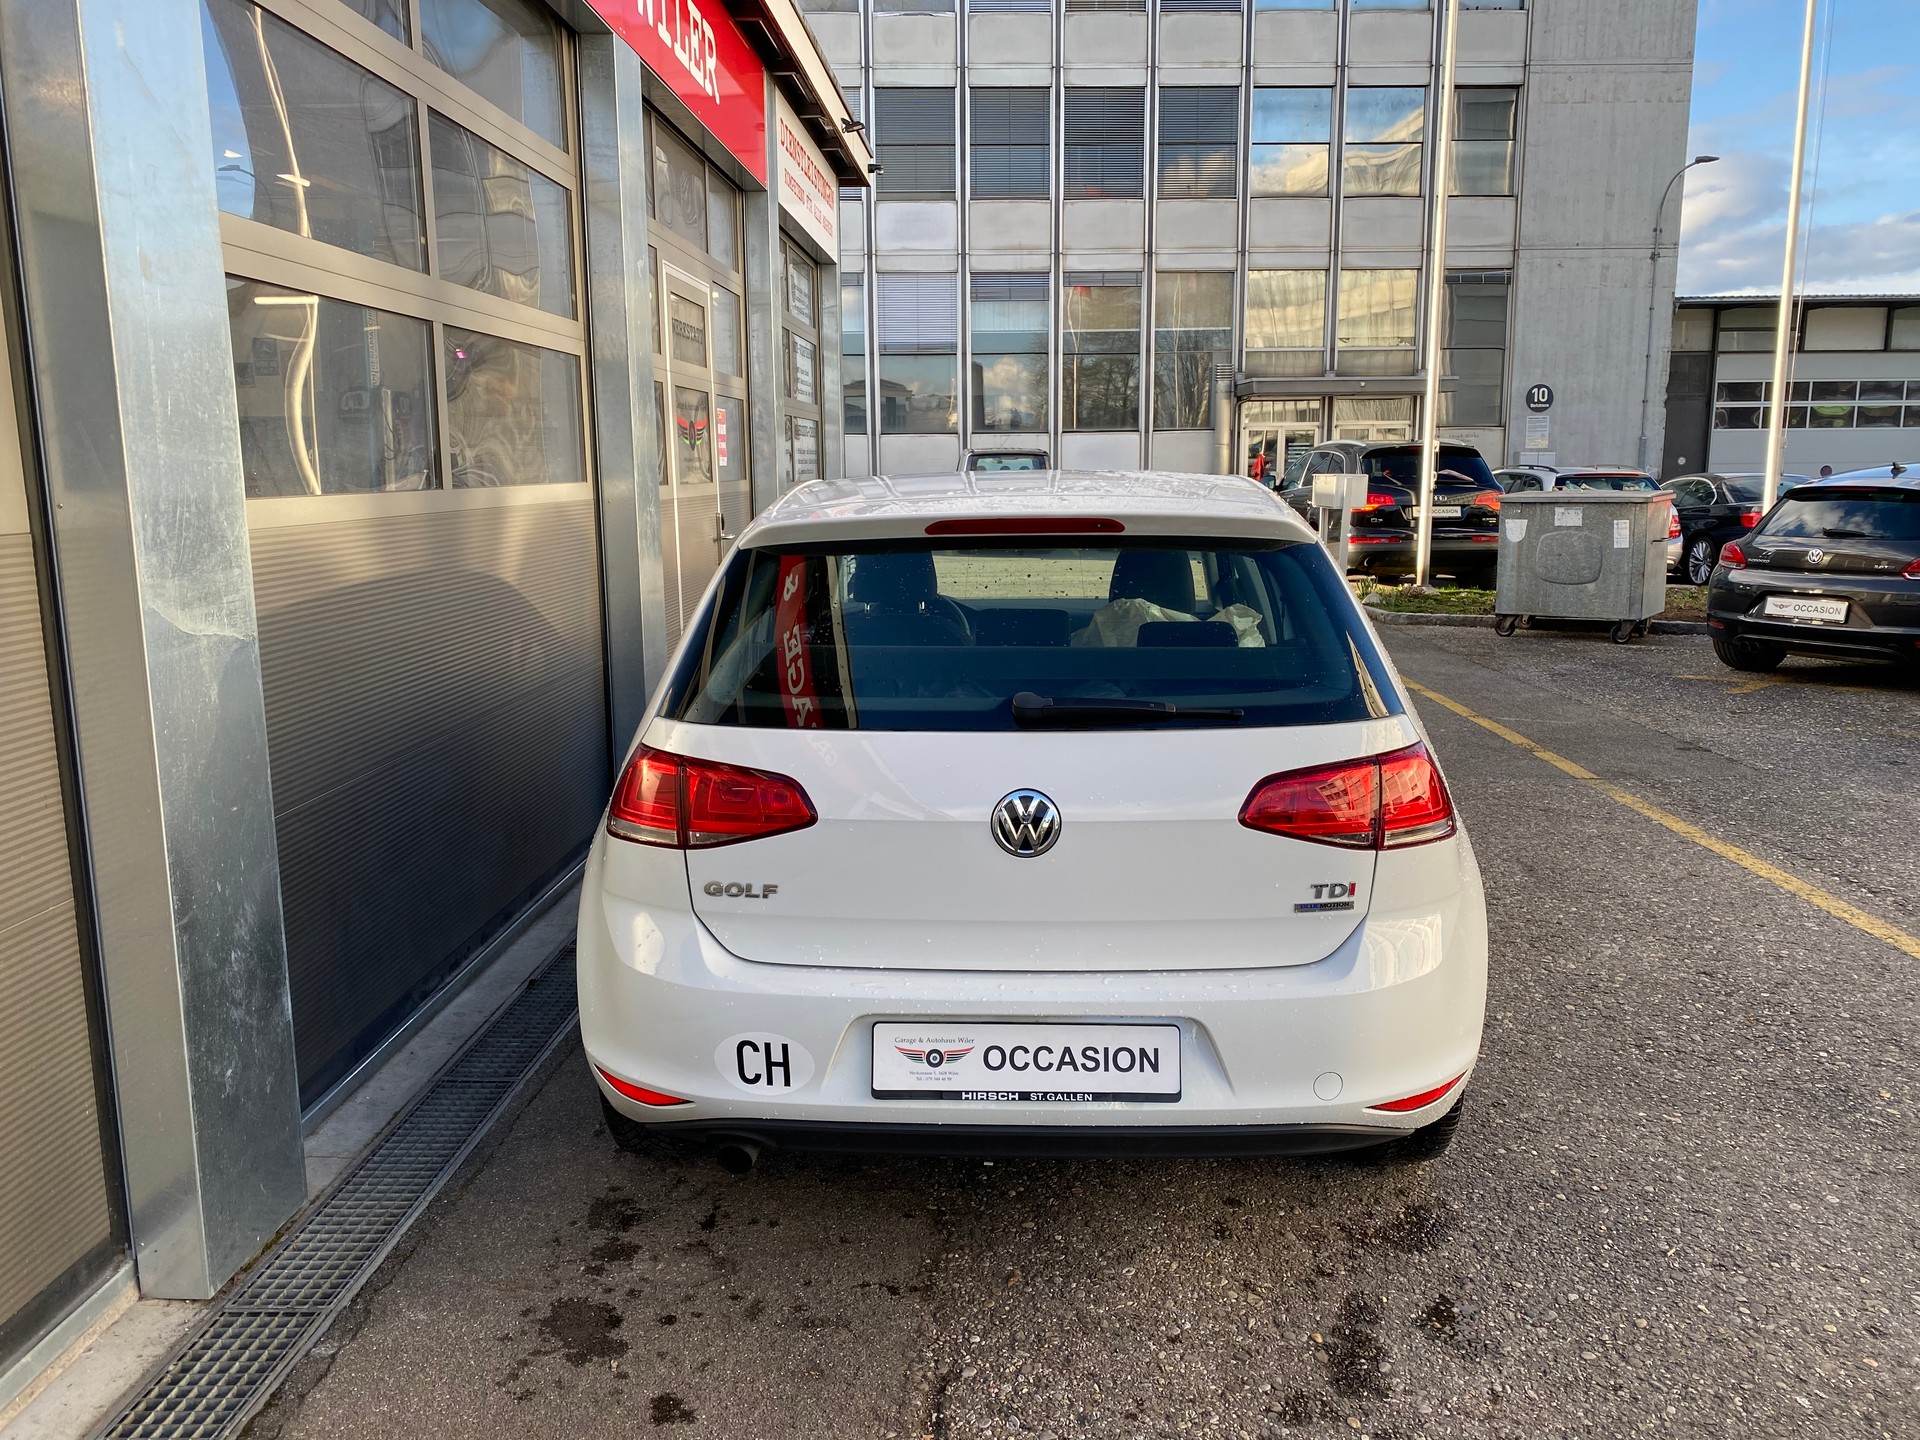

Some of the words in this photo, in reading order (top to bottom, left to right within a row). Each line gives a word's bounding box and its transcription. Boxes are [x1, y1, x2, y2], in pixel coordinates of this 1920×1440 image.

[1532, 388, 1548, 402] 10
[1793, 604, 1842, 615] OCCASION
[703, 880, 778, 899] GOLF
[1310, 882, 1356, 899] TDI
[894, 1037, 917, 1045] Garage
[736, 1039, 791, 1087] CH
[983, 1045, 1159, 1073] OCCASION
[962, 1091, 1019, 1101] HIRSCH
